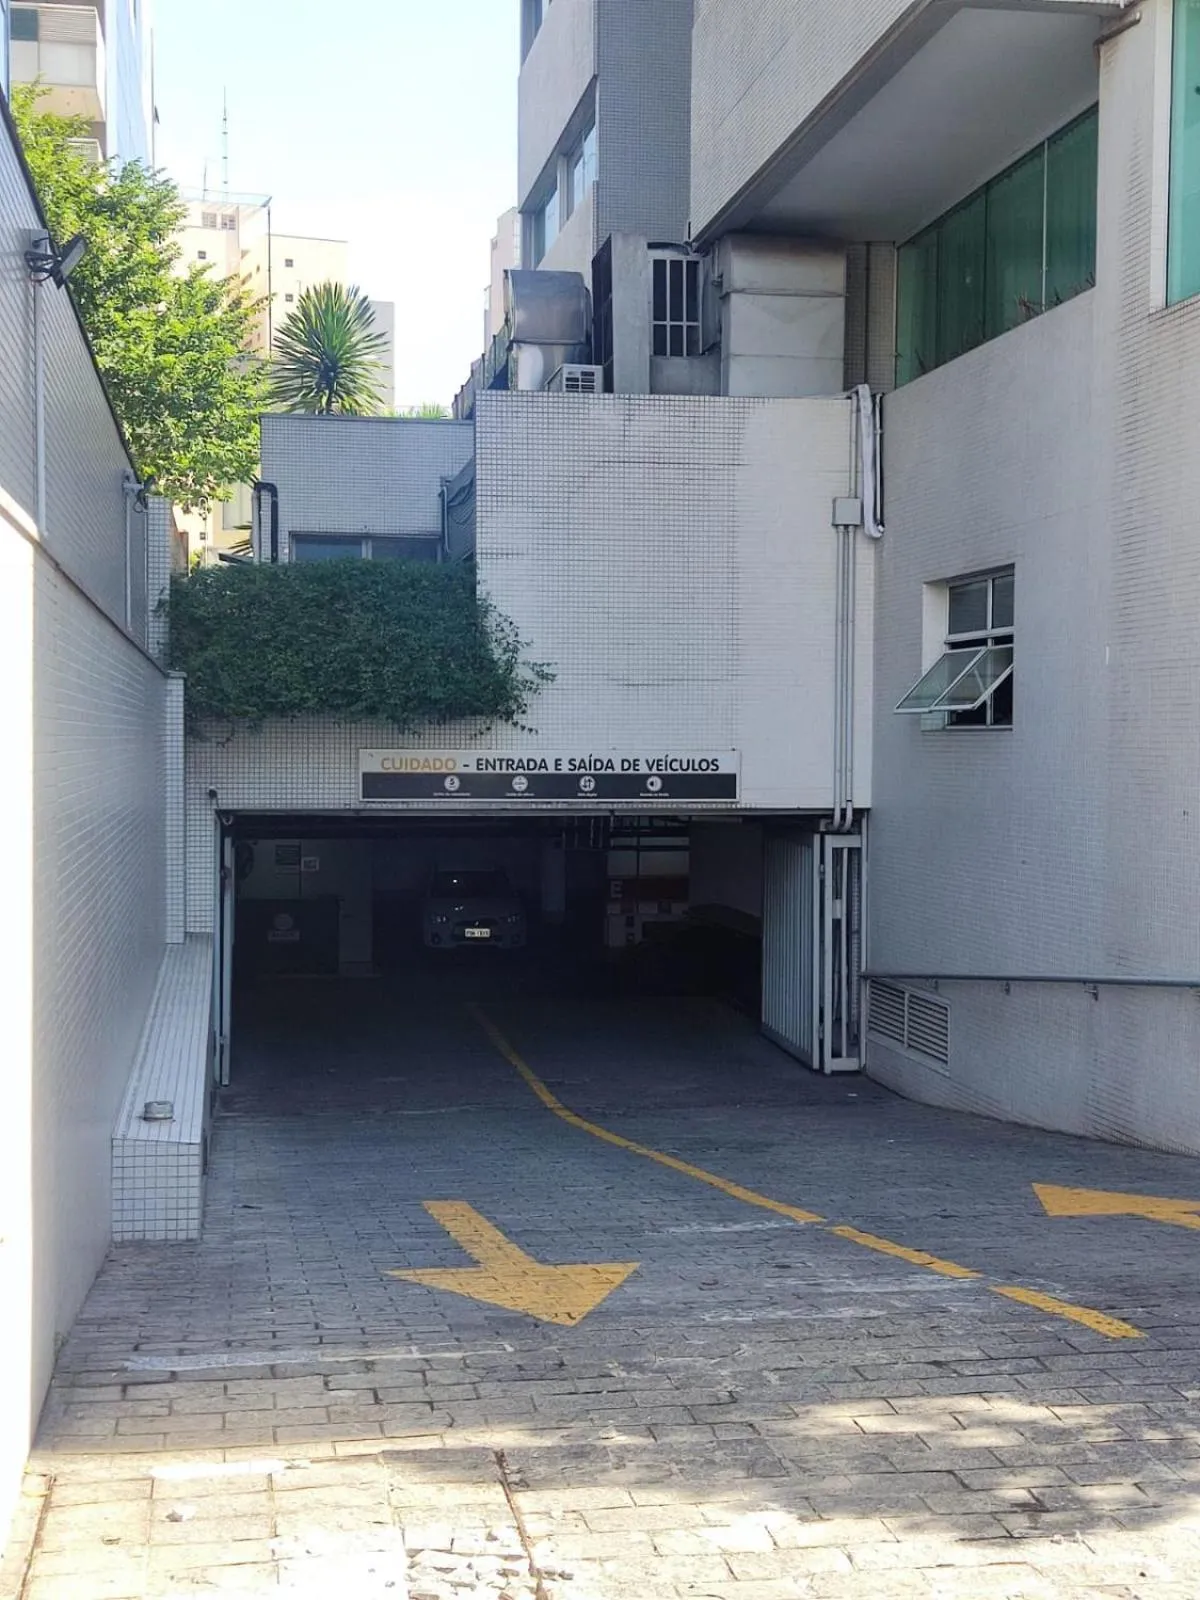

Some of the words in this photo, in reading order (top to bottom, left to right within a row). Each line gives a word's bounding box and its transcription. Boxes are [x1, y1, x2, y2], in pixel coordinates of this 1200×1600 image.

[381, 757, 457, 771] CUIDADO
[476, 758, 549, 771] ENTRADA
[554, 758, 563, 771] E
[568, 754, 615, 772] SAÍDA
[620, 758, 641, 772] DE
[645, 754, 720, 772] VEÍCULOS
